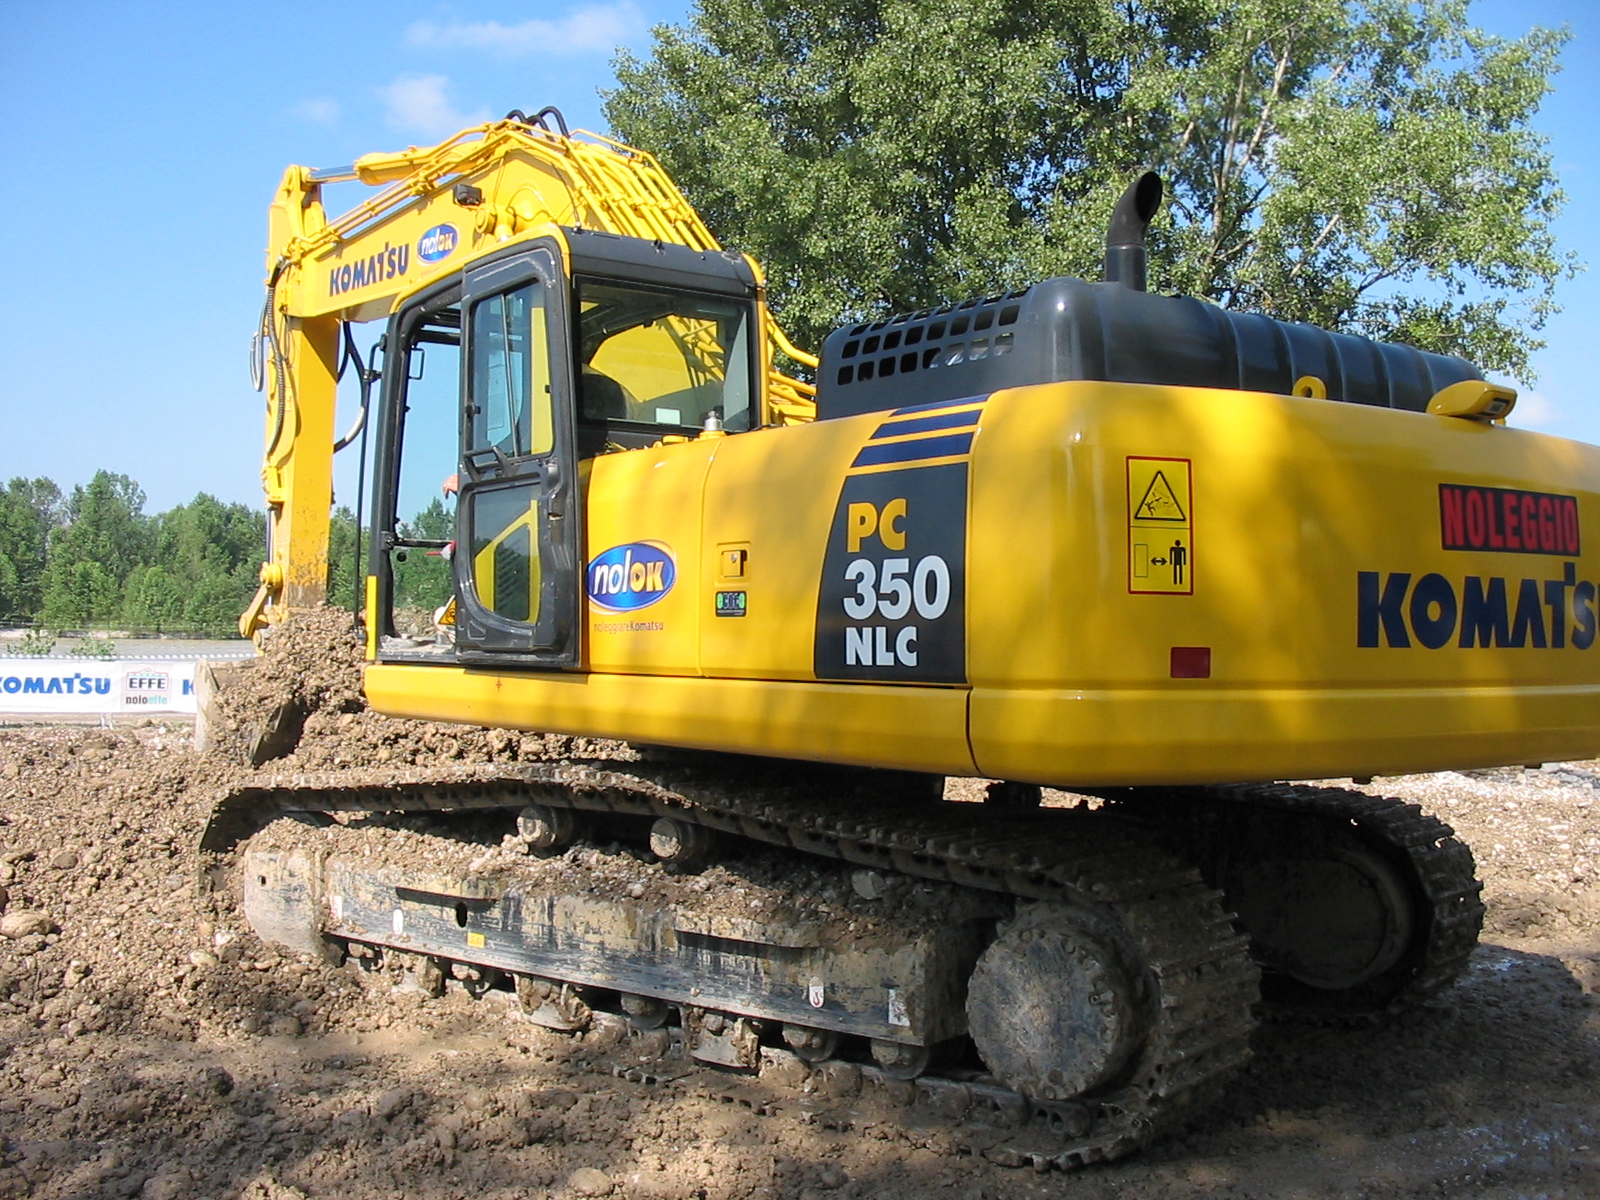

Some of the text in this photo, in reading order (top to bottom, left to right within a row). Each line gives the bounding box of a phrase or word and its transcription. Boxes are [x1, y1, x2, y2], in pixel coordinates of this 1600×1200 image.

[329, 241, 410, 297] KOMATSU
[847, 497, 907, 553] PC
[1441, 487, 1579, 554] NOLEGGIO
[843, 554, 951, 621] 350
[1357, 561, 1600, 650] KOMATS
[845, 625, 918, 667] NLC
[0, 672, 112, 695] OMATSU
[128, 677, 167, 690] EFFE
